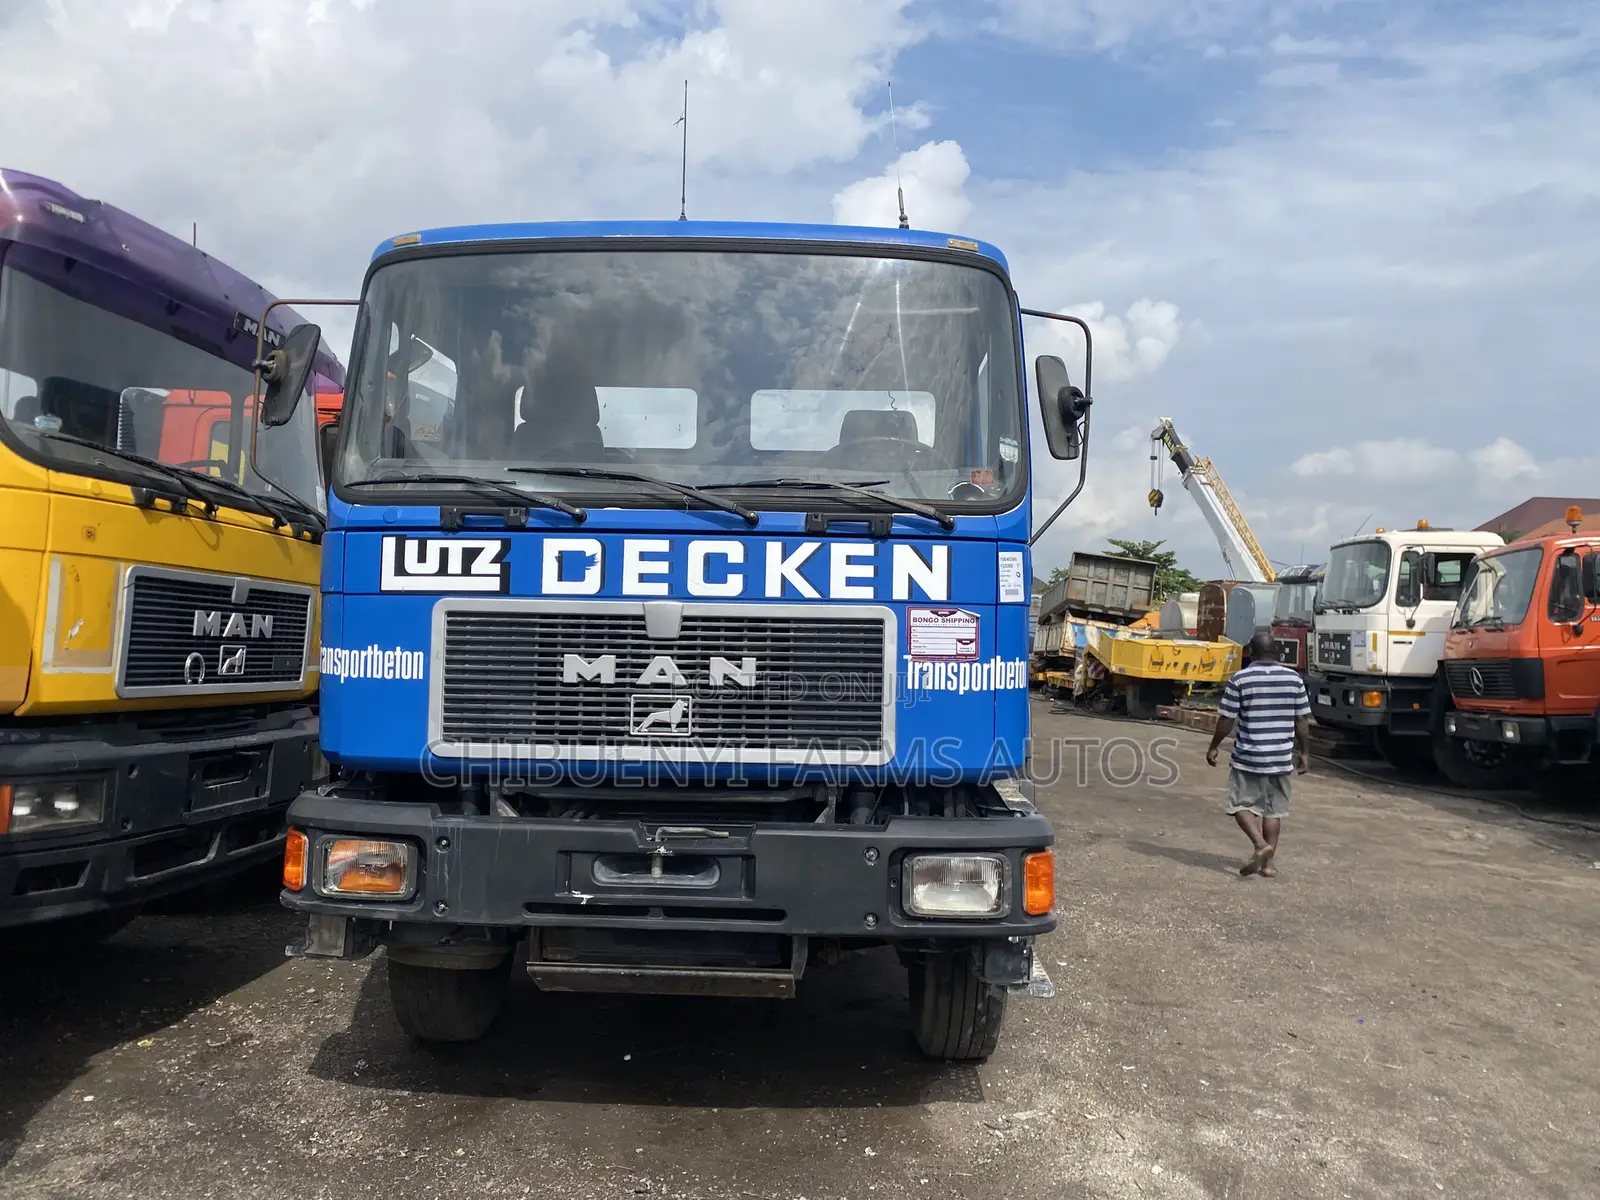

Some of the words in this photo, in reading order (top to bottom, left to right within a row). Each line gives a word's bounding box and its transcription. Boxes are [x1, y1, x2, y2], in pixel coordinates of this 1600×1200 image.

[380, 536, 502, 592] LUTZ
[541, 538, 951, 600] DECKEN
[192, 609, 274, 639] MAN
[912, 616, 939, 624] BONGO
[562, 653, 757, 686] MAN
